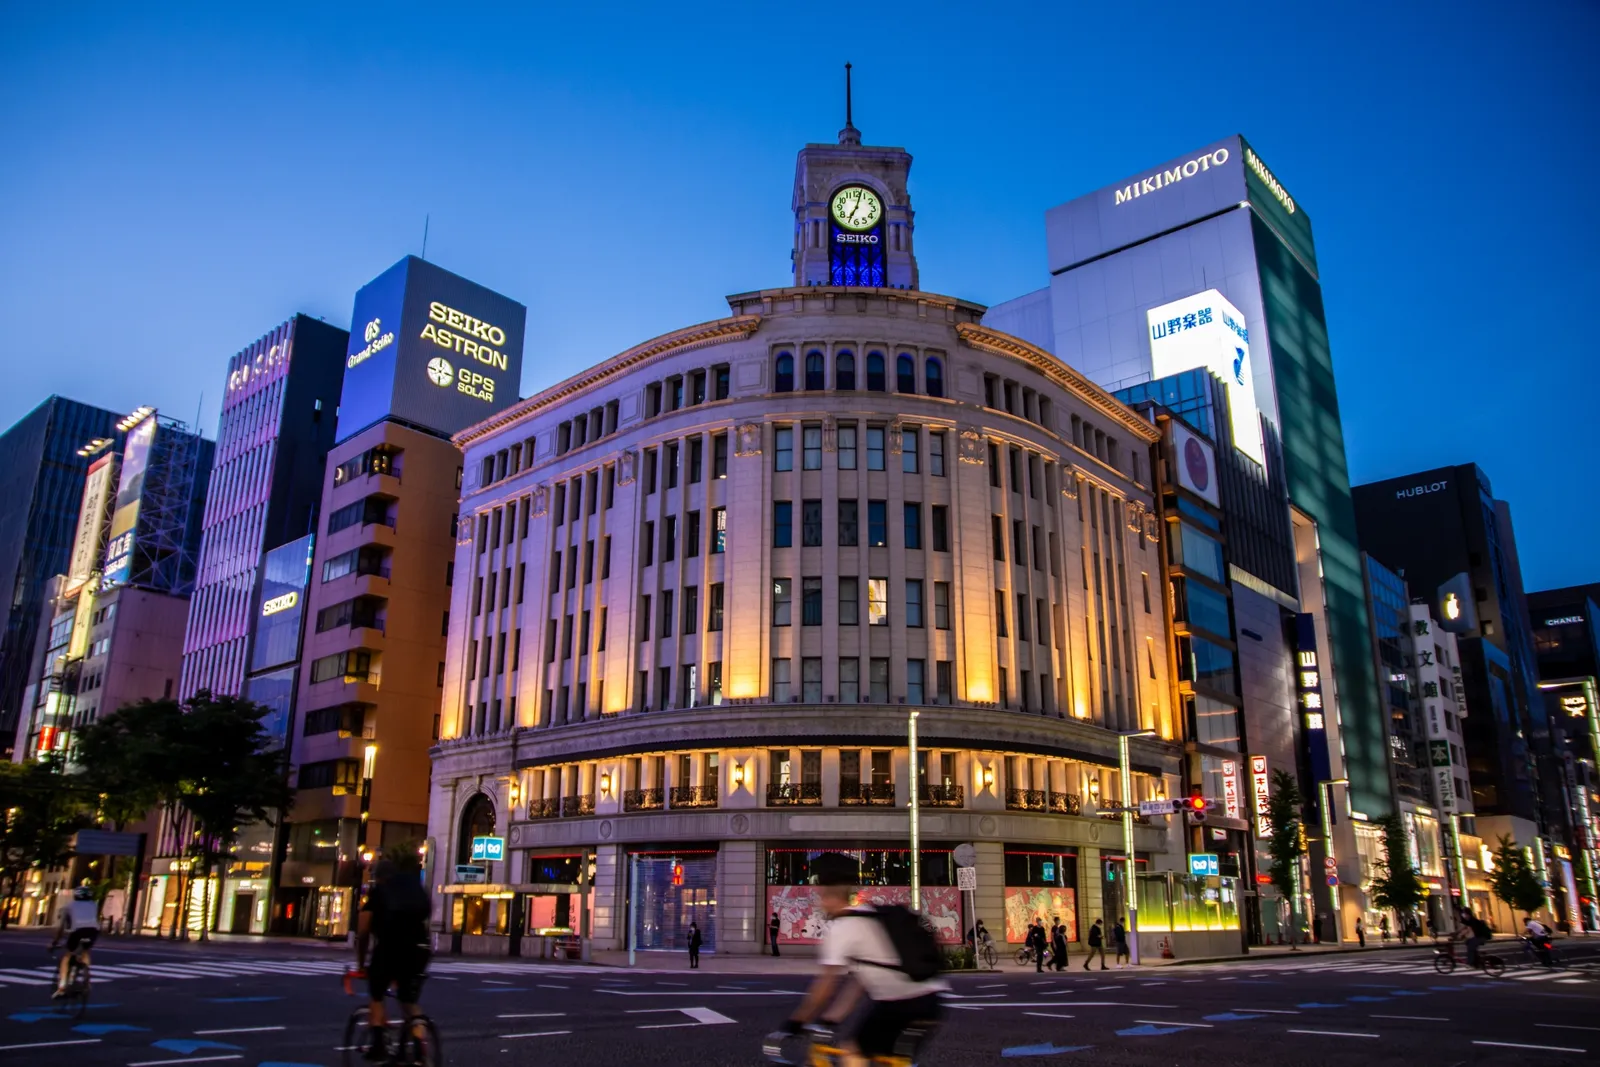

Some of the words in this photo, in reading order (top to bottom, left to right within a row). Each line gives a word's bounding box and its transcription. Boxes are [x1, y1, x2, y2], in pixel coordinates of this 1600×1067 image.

[1114, 148, 1230, 205] MIKIMOTO
[1246, 148, 1295, 214] MIKIMOTO
[836, 234, 878, 244] SEIKO
[364, 317, 381, 343] GS
[429, 301, 506, 346] SEIKO
[1152, 307, 1213, 340] 山野楽器
[347, 344, 372, 369] Grand
[371, 331, 395, 354] Seiko
[420, 323, 508, 371] ASTRON
[457, 382, 494, 403] SOLAR
[458, 368, 495, 393] GPS
[1396, 480, 1448, 499] HUBLOT
[263, 591, 298, 616] SEIKO
[1546, 615, 1584, 626] CHANEL
[1415, 619, 1439, 698] 教文館
[1431, 744, 1448, 763] 本
